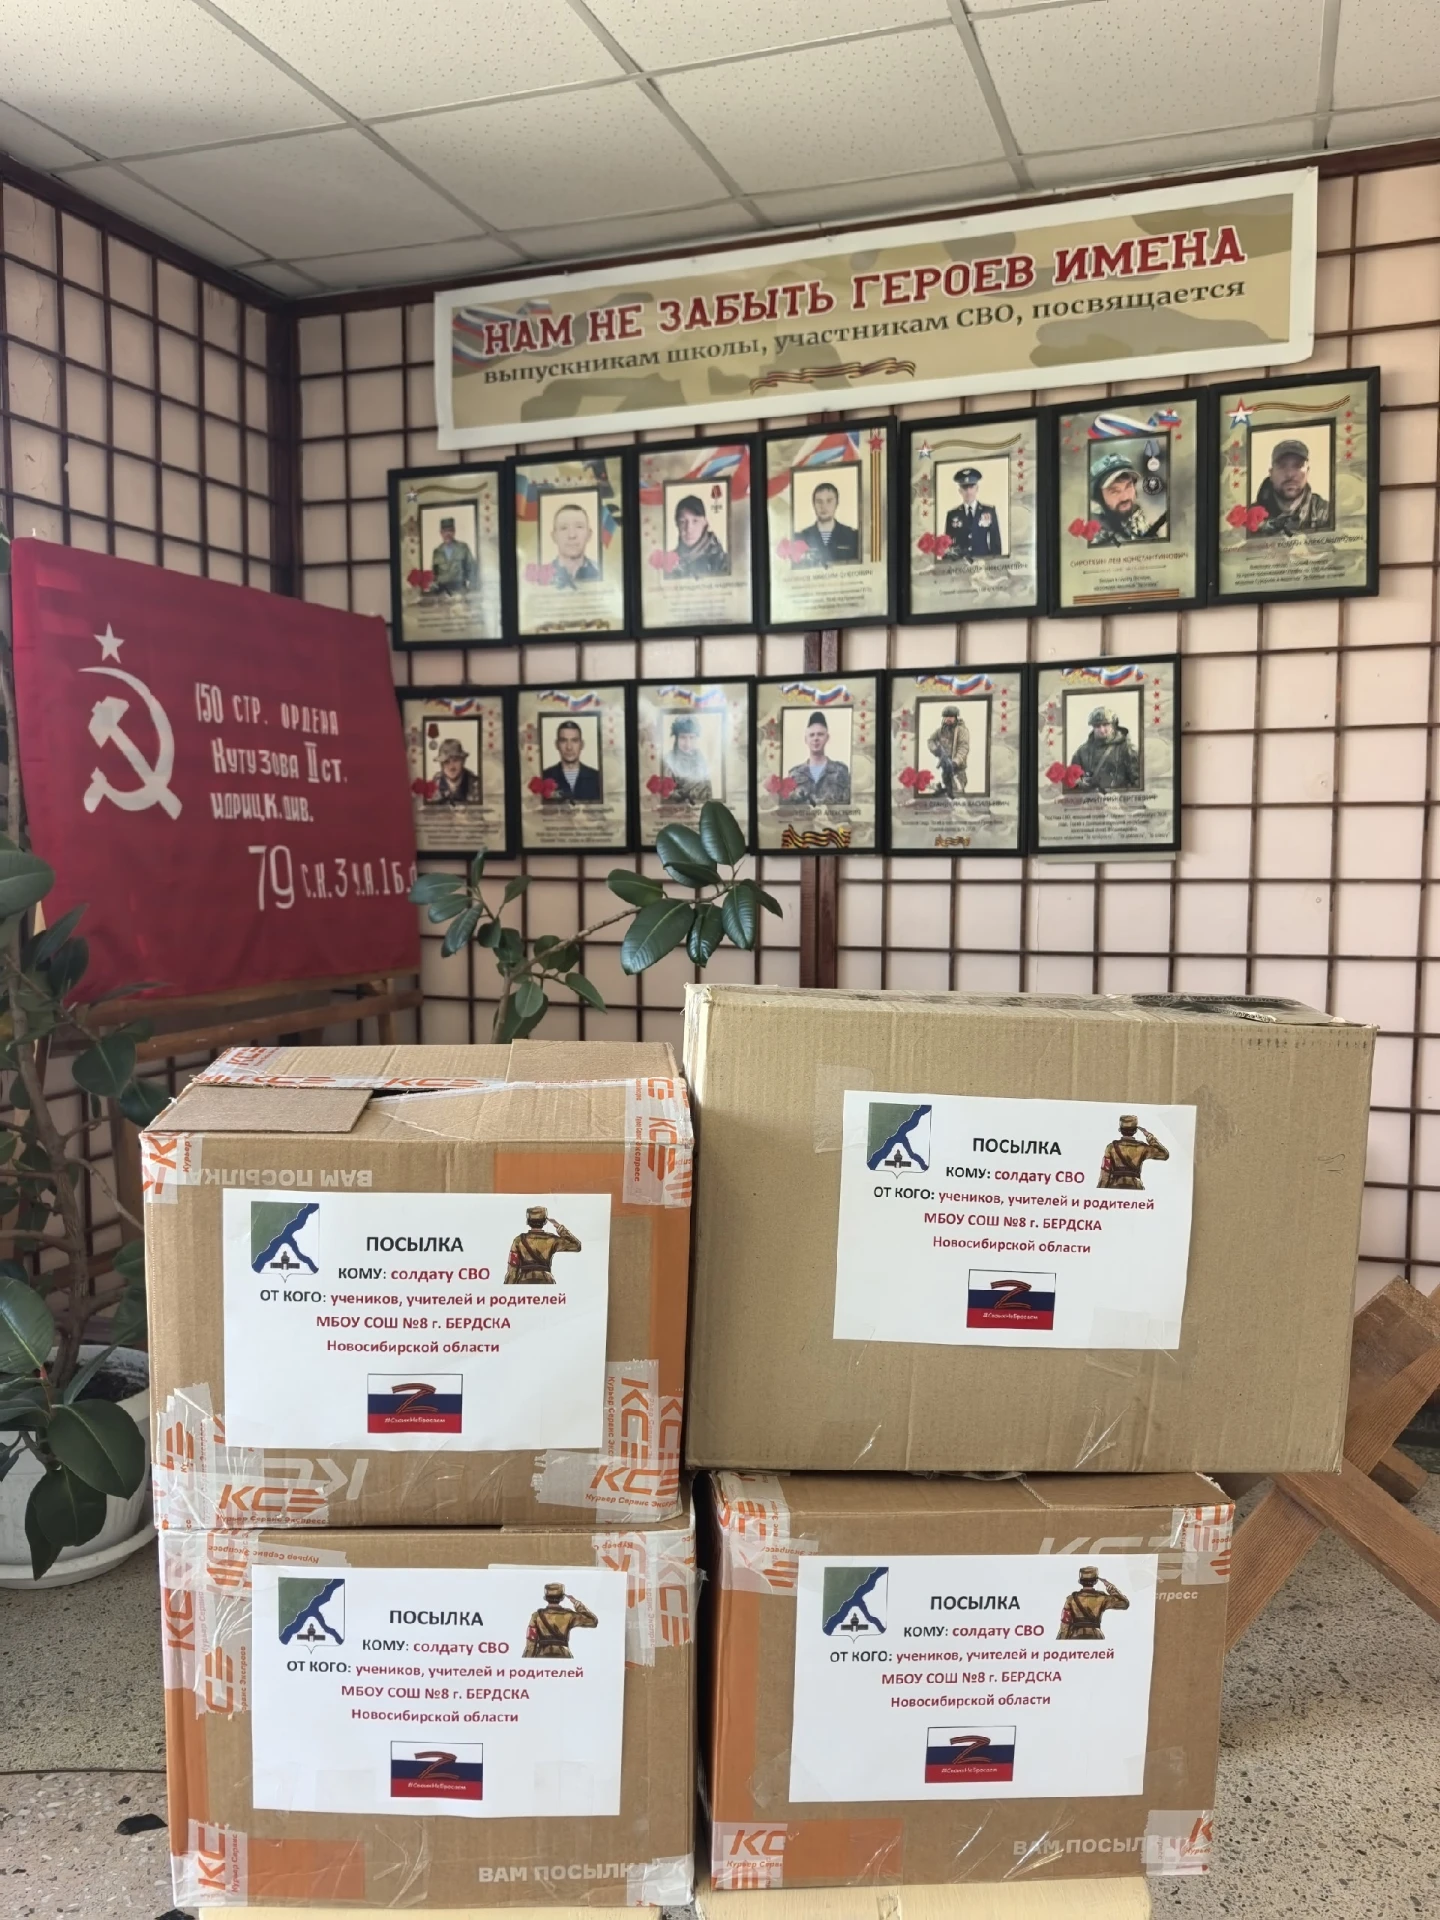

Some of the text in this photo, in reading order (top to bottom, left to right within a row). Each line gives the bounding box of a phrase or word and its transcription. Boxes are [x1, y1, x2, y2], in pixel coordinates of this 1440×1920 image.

[483, 226, 1246, 357] НАМ НЕ ЗАБЫТЬ ГЕРОЕВ ИМЕНА
[483, 279, 1246, 385] выпускникам школы, участникам СВО, посвящается
[195, 682, 339, 736] 150 СТР. ОРДЕНА
[249, 845, 296, 911] 79
[973, 1138, 1061, 1155] ПОСЫЛКА
[321, 1170, 373, 1187] ВАМ
[946, 1167, 1085, 1185] КОМУ: солдату СВО
[874, 1186, 1154, 1210] ОТ КОГО: учеников, учителей и родителей
[925, 1213, 1102, 1232] МБОУ СОШ №8 г. БЕРДСКА
[367, 1237, 464, 1252] ПОСЫЛКА
[933, 1236, 1090, 1253] Новосибирской области
[339, 1268, 490, 1283] КОМУ: солдату СВО
[260, 1290, 566, 1307] ОТ КОГО: учеников, учителей и родителей
[317, 1316, 360, 1328] МБОУ
[364, 1317, 398, 1328] СОШ
[403, 1318, 428, 1329] №8
[446, 1318, 510, 1331] БЕРДСКА
[328, 1340, 499, 1355] Новосибирской области
[585, 1493, 616, 1504] Курьер
[618, 1497, 649, 1506] Сервис
[930, 1596, 1020, 1610] ПОСЫЛКА
[390, 1610, 483, 1626] ПОСЫЛКА
[904, 1625, 1044, 1639] КОМУ: солдату СВО
[363, 1639, 509, 1656] КОМУ: солдату СВО
[830, 1652, 848, 1662] ОТ
[852, 1651, 892, 1662] КОГО:
[897, 1652, 962, 1664] учеников,
[966, 1649, 1027, 1662] учителей
[1043, 1648, 1114, 1661] родителей
[287, 1661, 583, 1679] ОТ КОГО: учеников, учителей и родителей
[882, 1674, 923, 1684] МБОУ
[926, 1673, 957, 1683] СОШ
[963, 1672, 985, 1683] №8
[1002, 1672, 1061, 1684] БЕРДСКА
[342, 1686, 529, 1701] МБОУ СОШ №8 г. БЕРДСКА
[891, 1694, 1050, 1709] Новосибирской области
[352, 1709, 518, 1724] Новосибирской области
[1013, 1840, 1060, 1856] ВАМ
[478, 1867, 527, 1883] ВАМ
